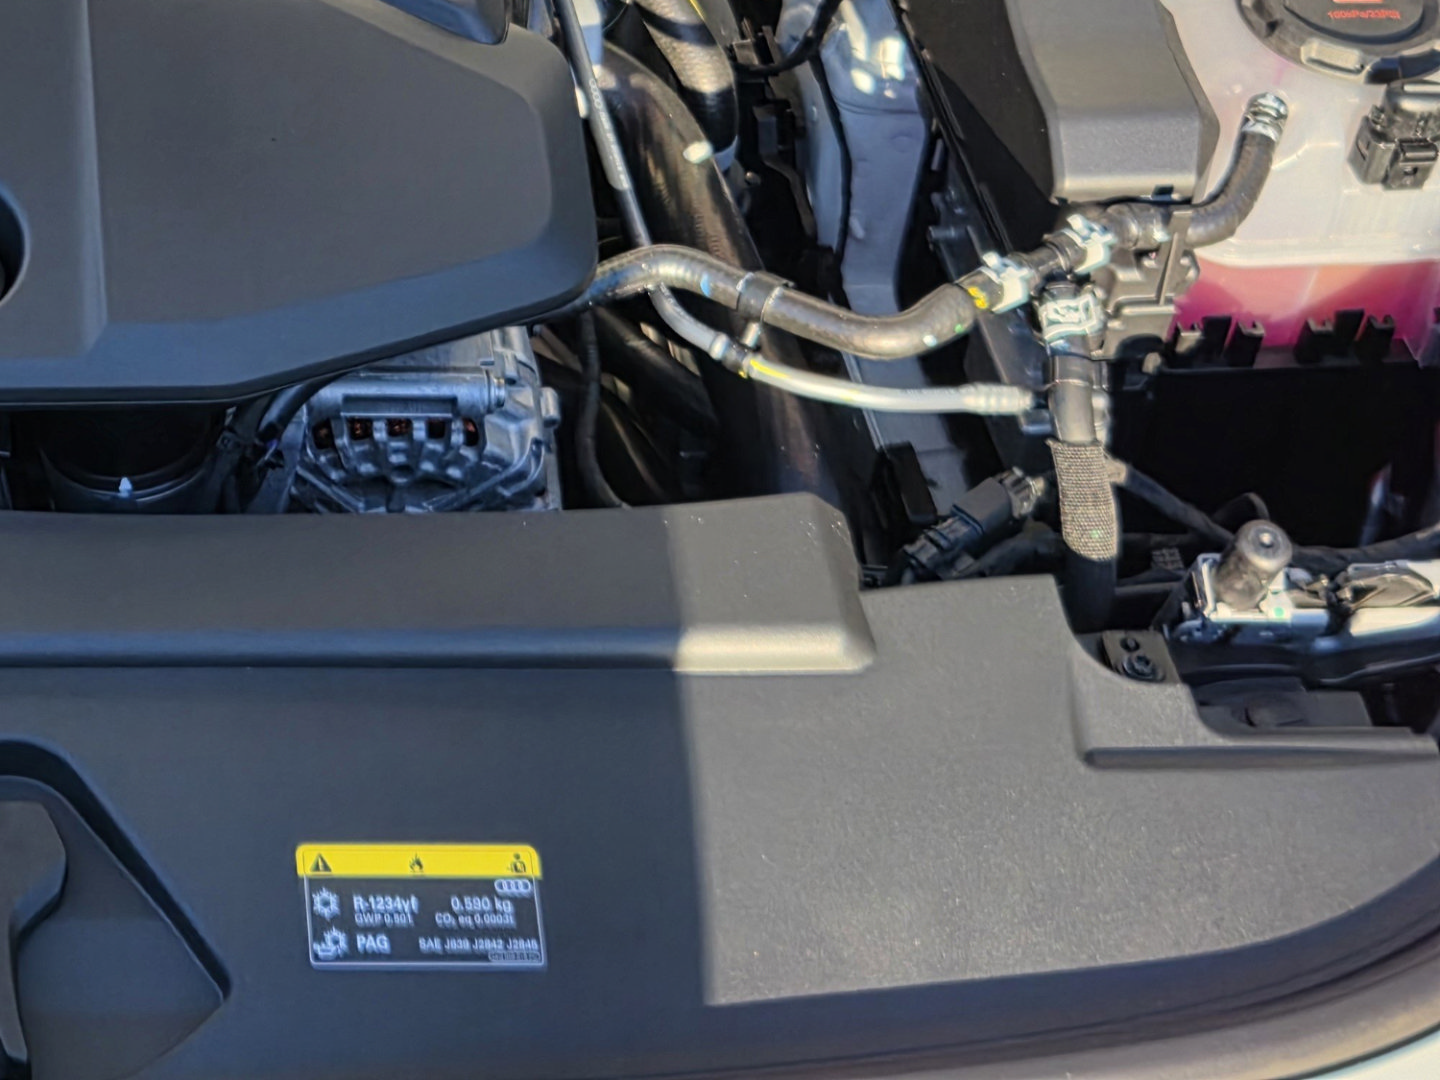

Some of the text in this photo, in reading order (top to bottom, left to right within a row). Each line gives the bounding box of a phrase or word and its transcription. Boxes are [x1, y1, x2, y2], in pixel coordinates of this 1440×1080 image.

[353, 894, 513, 914] R-1234yf 0.590 kg
[354, 912, 381, 926] GWP
[458, 913, 473, 927] eq
[356, 934, 390, 951] PAG
[418, 936, 441, 951] SAE
